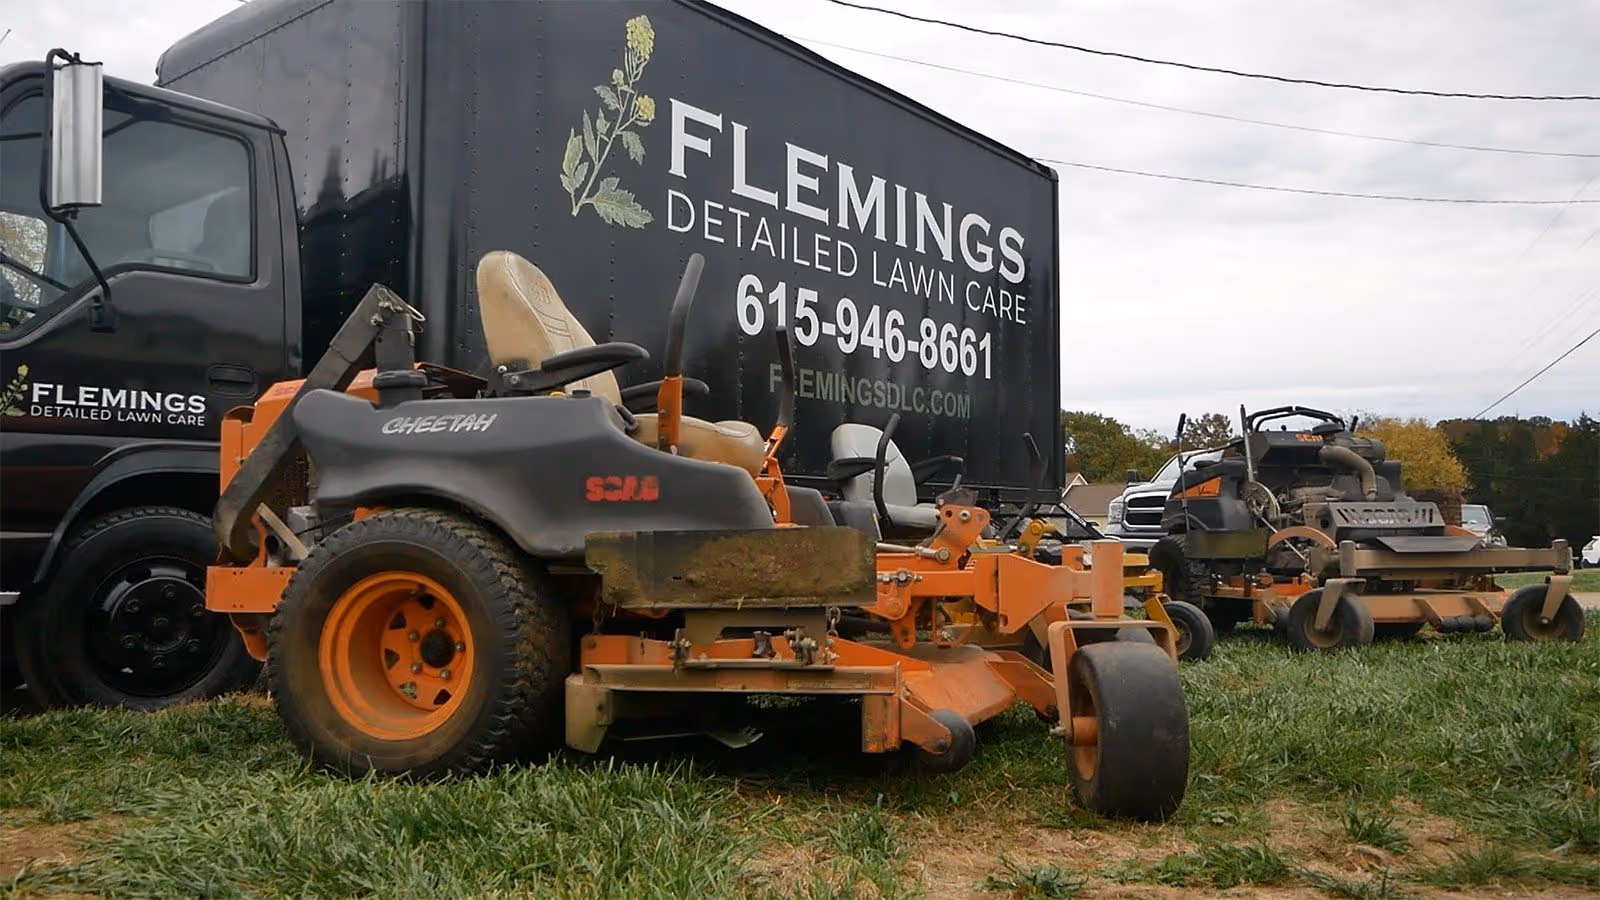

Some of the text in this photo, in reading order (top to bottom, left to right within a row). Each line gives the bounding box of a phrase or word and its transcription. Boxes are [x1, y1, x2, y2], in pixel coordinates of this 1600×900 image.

[668, 97, 1027, 285] FLEMINGS
[666, 189, 1027, 325] DETAILED LAWN CARE
[736, 273, 993, 379] 615-946-8661
[30, 404, 206, 427] DETAILED LAWN CARE
[31, 382, 207, 414] FLEMINGS
[769, 363, 971, 420] FEMINGSDLC.COM
[381, 413, 498, 435] CHEETAH
